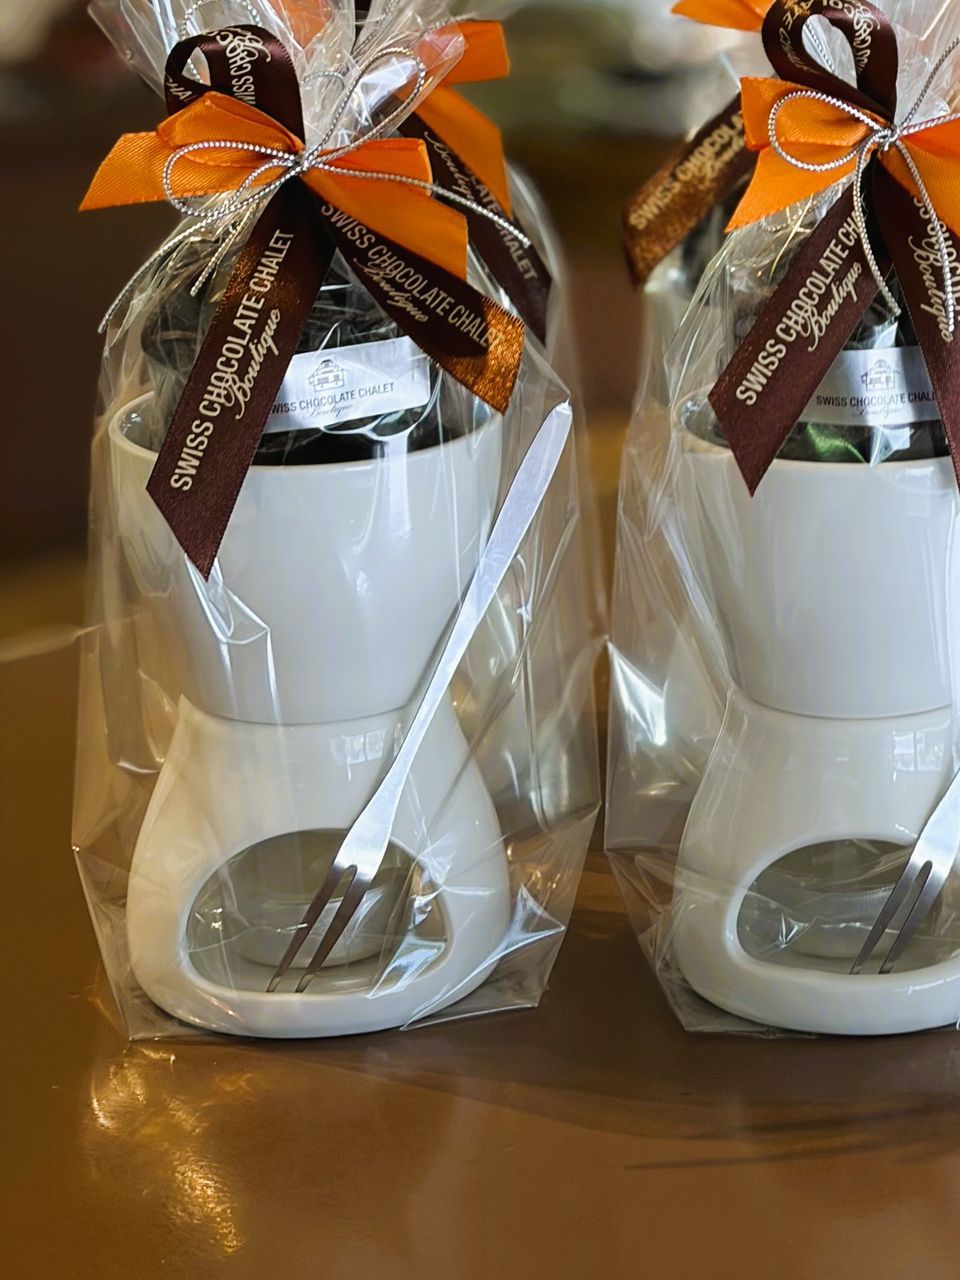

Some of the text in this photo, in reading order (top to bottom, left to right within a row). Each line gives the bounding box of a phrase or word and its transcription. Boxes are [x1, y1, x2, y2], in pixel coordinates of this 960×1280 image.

[321, 204, 375, 249] SWISS
[368, 245, 455, 317] CHOCOLATE
[736, 210, 863, 405] SWISS CHOCOLATE CHA
[799, 262, 862, 352] Boutique
[170, 229, 294, 491] SWISS CHOCOLATE CHALET
[222, 308, 281, 419] Boutique
[272, 382, 395, 415] WISS CHOCOLATE CHALET
[816, 391, 936, 408] SWISS CHOCOLATE CHAL
